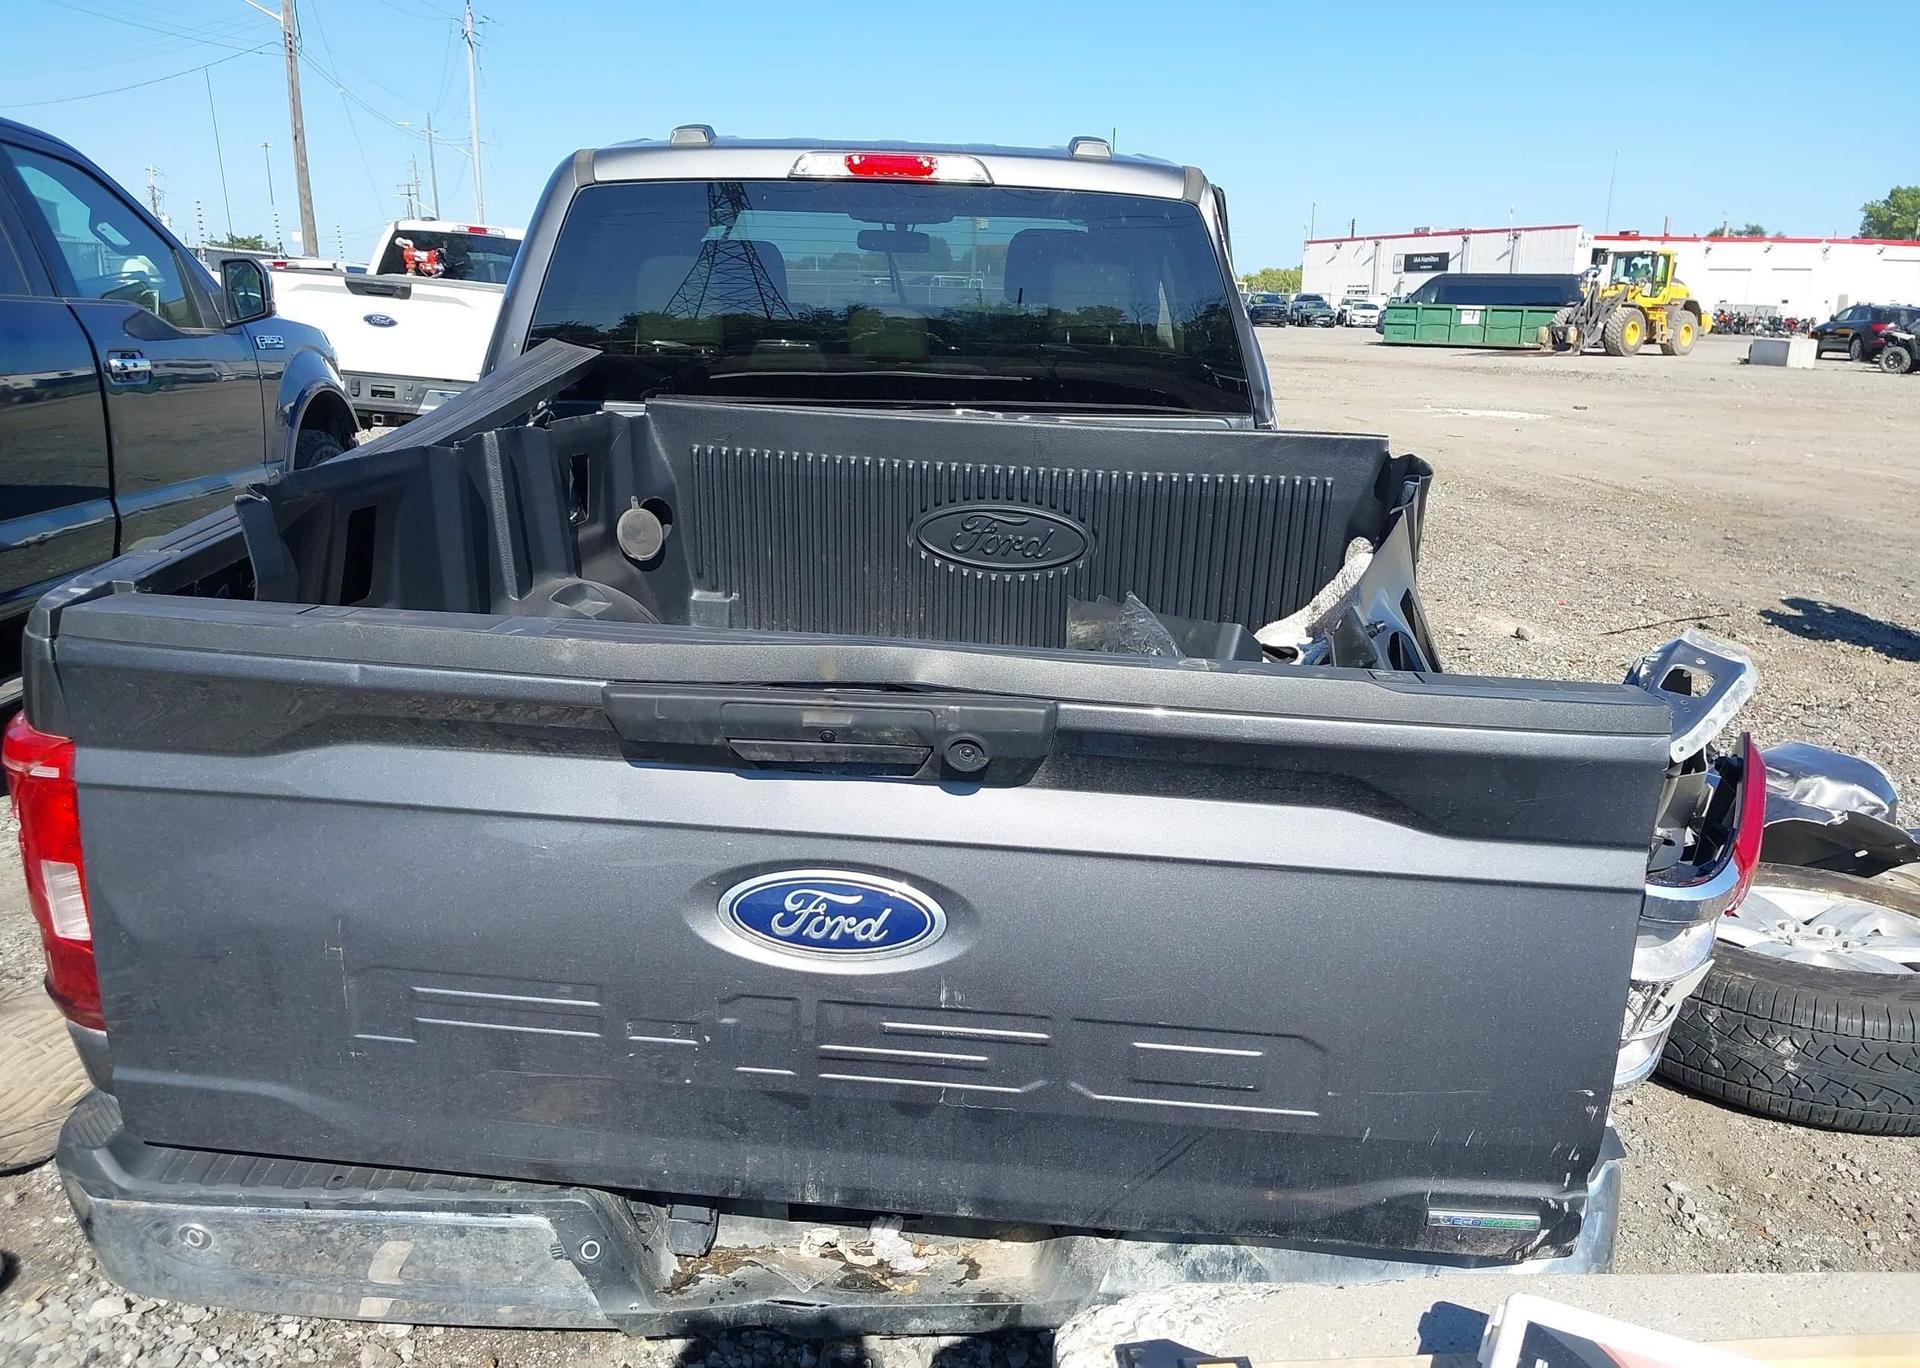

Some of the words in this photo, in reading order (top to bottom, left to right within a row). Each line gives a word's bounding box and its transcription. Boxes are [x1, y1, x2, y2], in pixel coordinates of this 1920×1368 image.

[370, 315, 391, 325] Ford
[951, 511, 1055, 559] Ford
[771, 888, 892, 942] Ford
